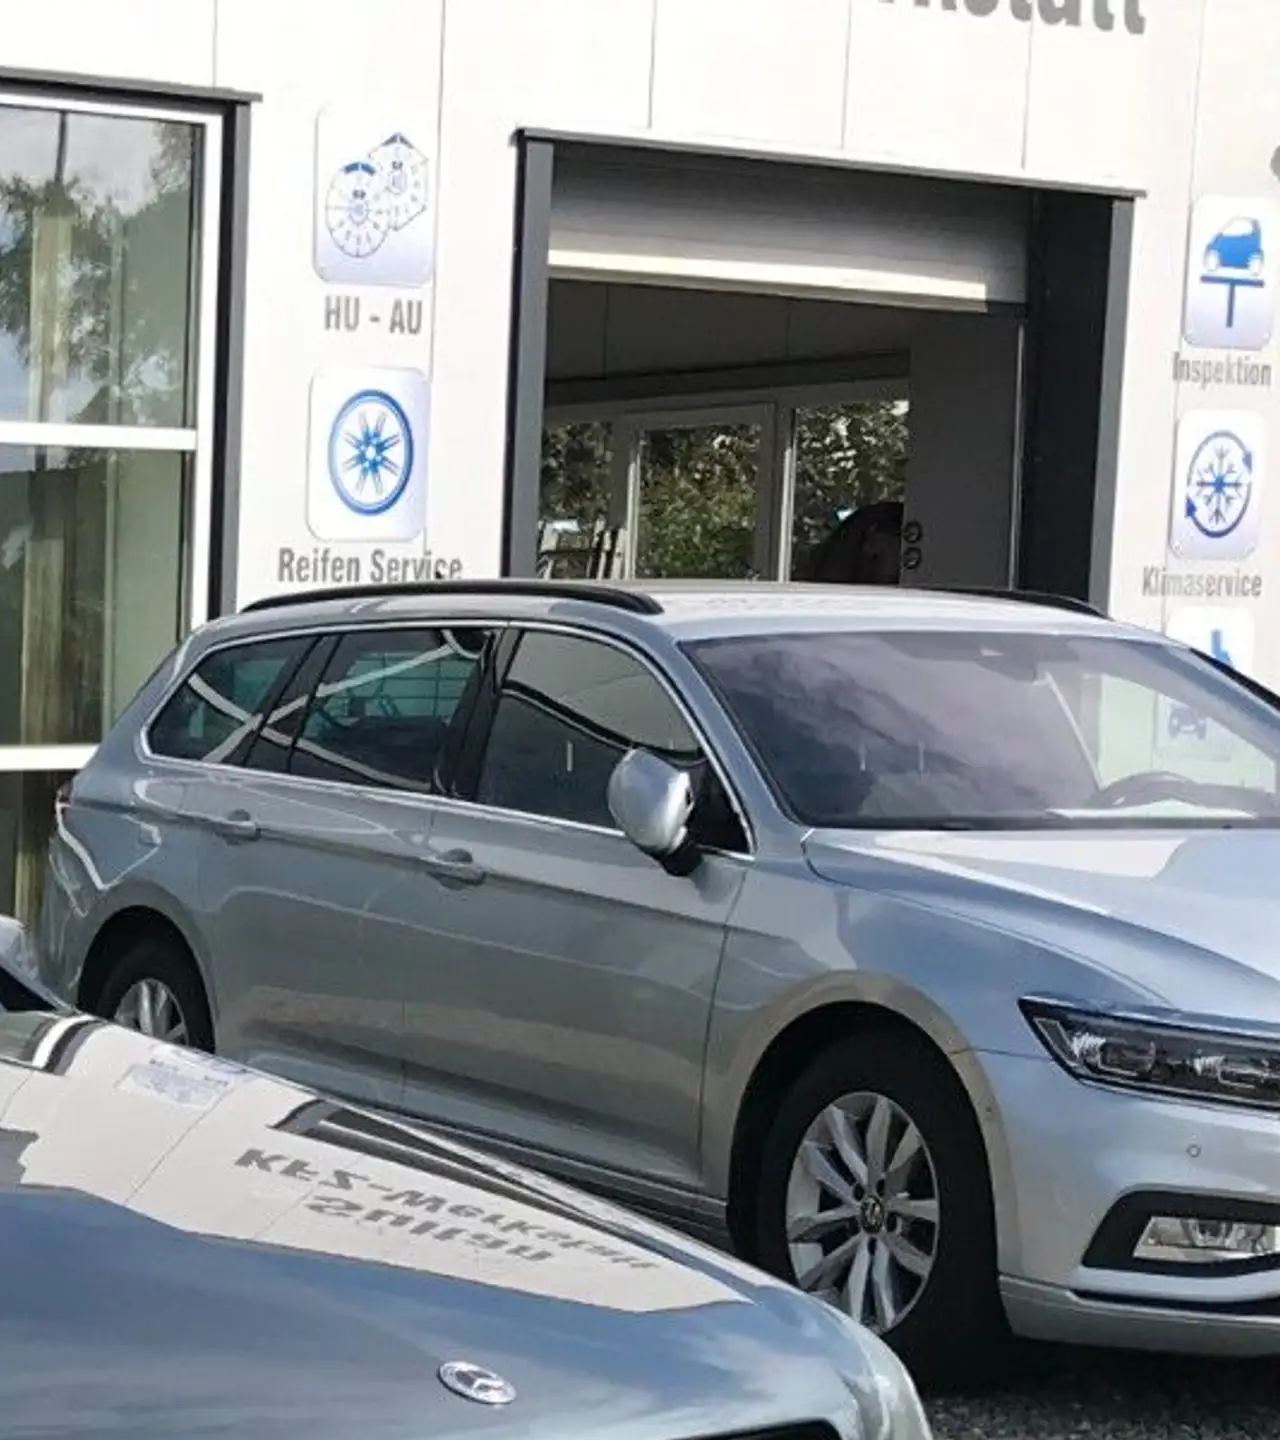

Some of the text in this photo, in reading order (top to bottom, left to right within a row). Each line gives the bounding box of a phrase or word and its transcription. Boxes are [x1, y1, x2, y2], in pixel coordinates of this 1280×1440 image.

[324, 295, 360, 331] HU
[389, 298, 422, 334] AU
[1172, 351, 1272, 391] Inspektion
[278, 547, 463, 582] Reifen Service
[1142, 565, 1262, 597] Klimaservice
